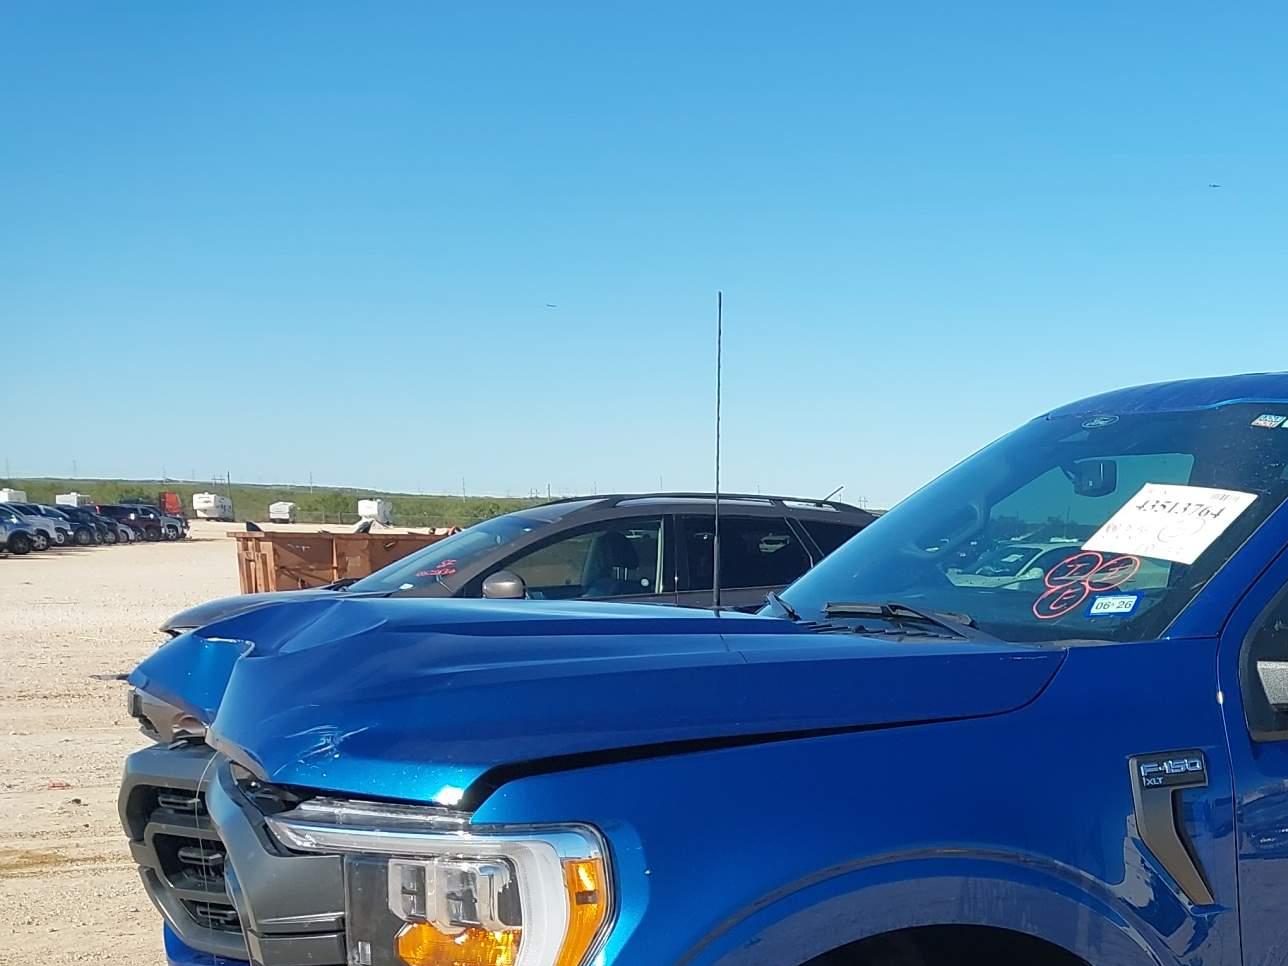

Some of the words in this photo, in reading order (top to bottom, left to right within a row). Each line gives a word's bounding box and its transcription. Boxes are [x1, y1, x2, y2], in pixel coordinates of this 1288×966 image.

[1135, 499, 1226, 519] 43513764
[1095, 601, 1111, 610] 06
[1116, 600, 1133, 609] 26
[1141, 759, 1201, 776] F-150
[1147, 777, 1163, 786] XLT
